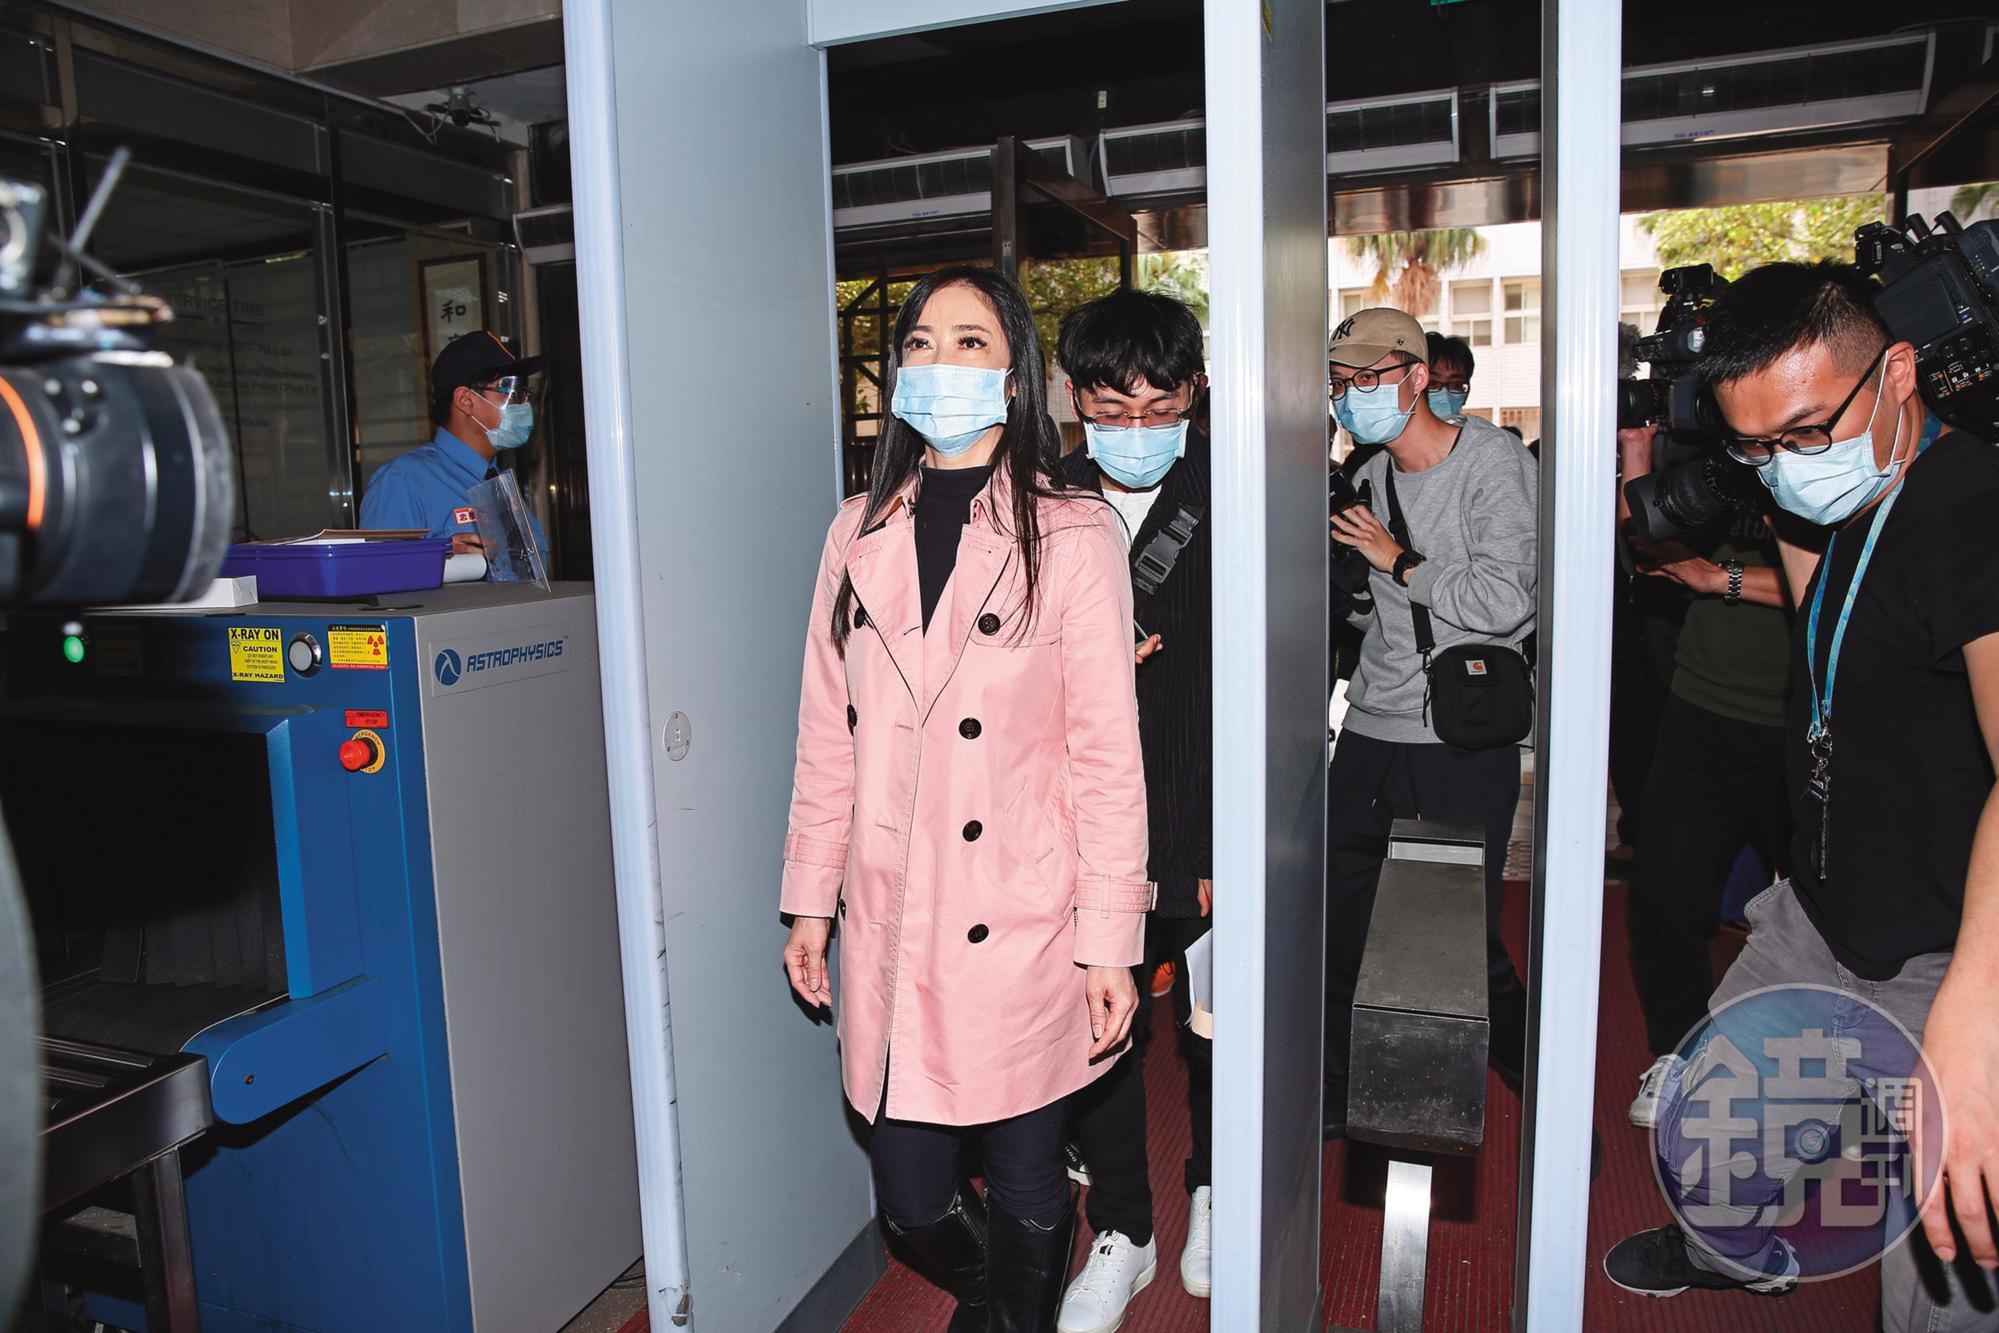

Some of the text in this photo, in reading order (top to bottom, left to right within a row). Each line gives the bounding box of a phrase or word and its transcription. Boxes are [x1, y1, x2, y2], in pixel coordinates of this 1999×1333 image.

[231, 300, 264, 315] TIME
[1332, 318, 1355, 341] NY
[230, 628, 279, 640] X-RAY ON
[243, 645, 278, 653] CAUTION
[466, 640, 563, 673] ASTROPHYSICS
